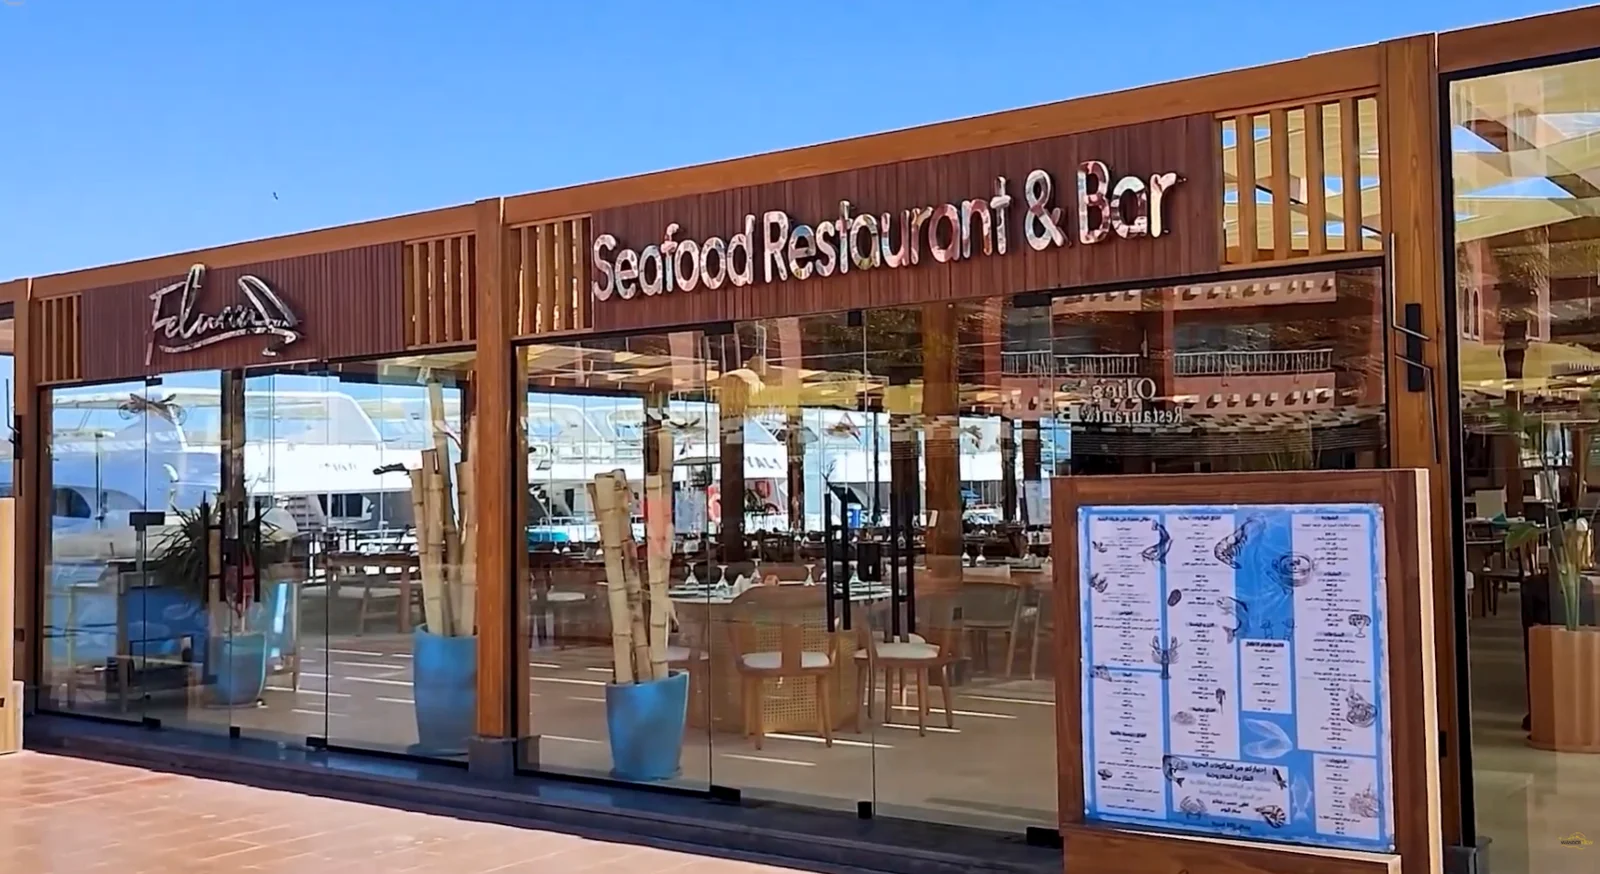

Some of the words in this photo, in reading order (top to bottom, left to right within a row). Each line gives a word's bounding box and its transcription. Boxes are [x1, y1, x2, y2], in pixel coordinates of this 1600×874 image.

[593, 214, 756, 302] Seafood
[763, 175, 1012, 284] Restaurant
[1025, 168, 1066, 252] &
[1076, 160, 1178, 245] Bar
